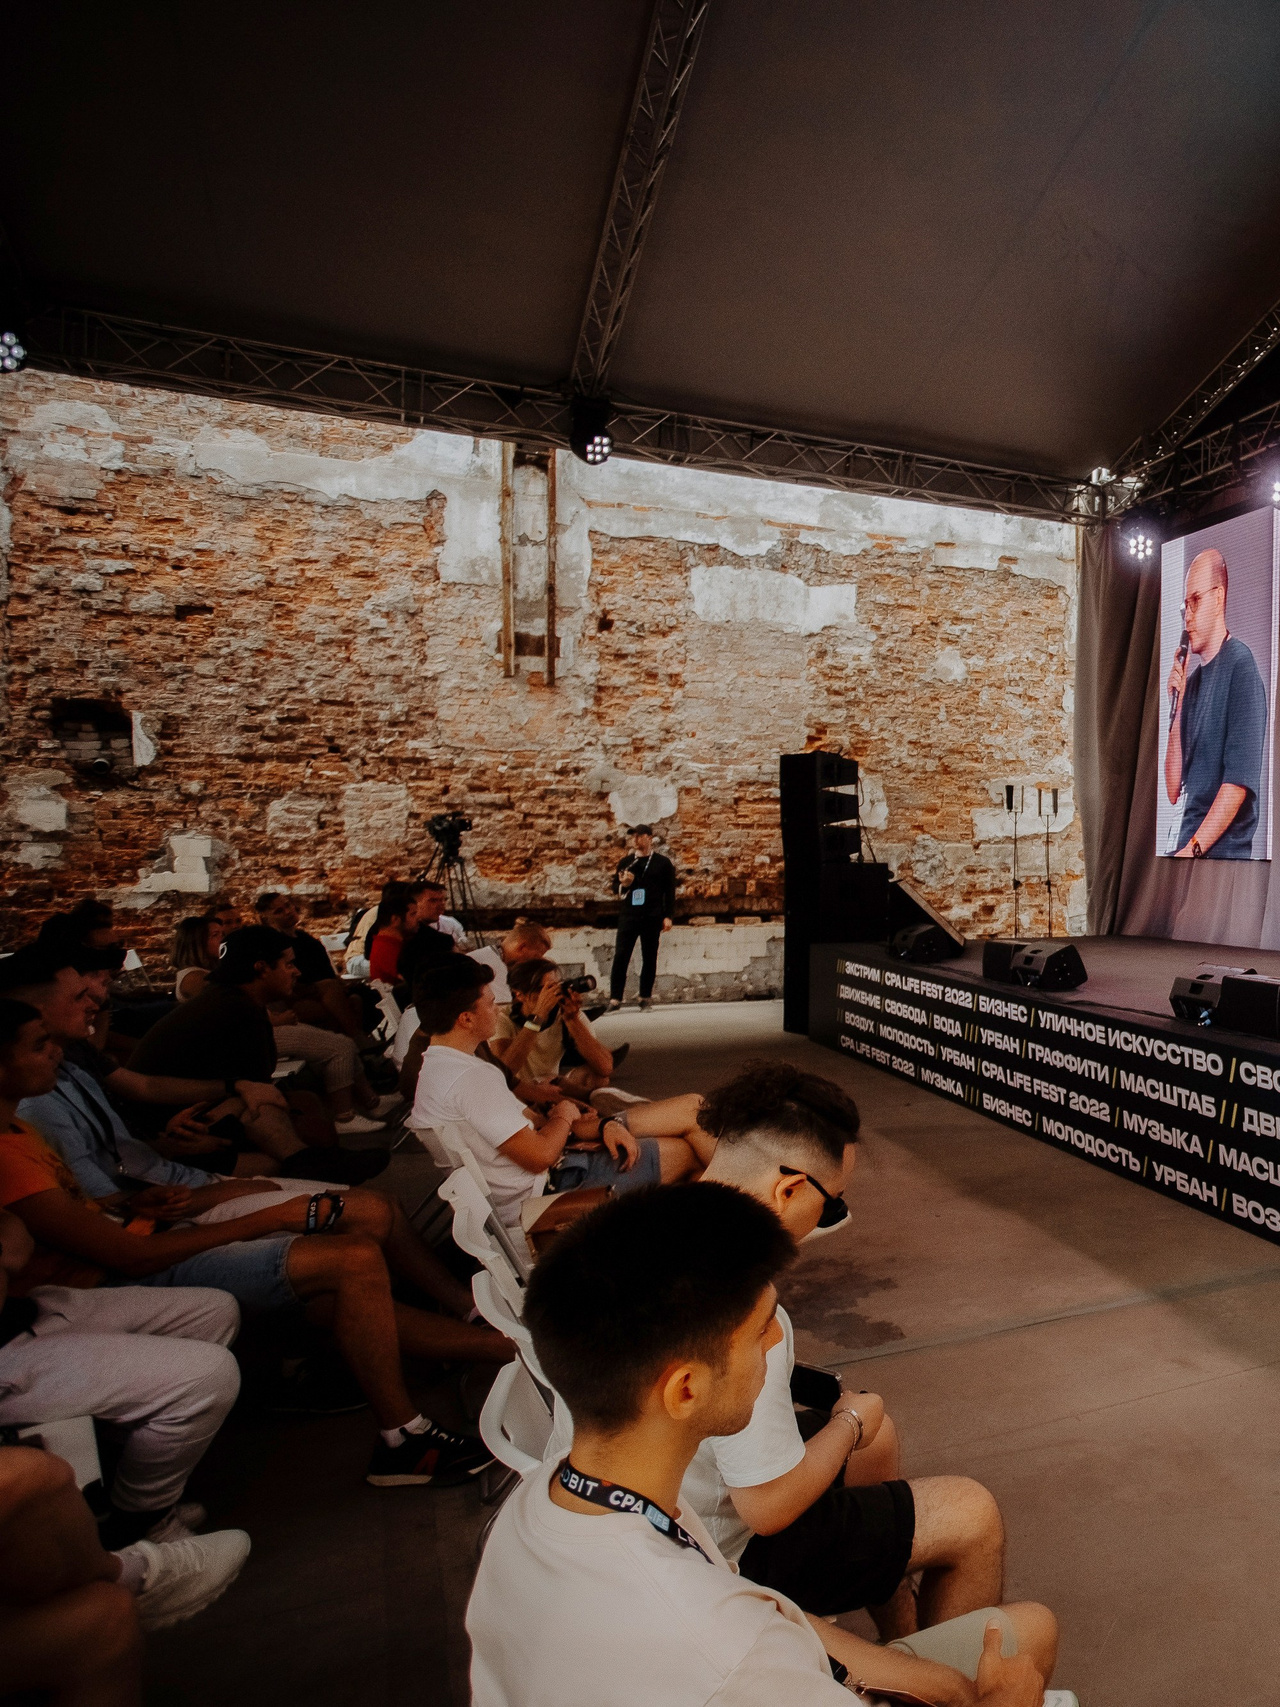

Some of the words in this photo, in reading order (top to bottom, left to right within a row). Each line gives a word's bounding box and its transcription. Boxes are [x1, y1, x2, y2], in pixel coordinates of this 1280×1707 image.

[839, 984, 881, 1009] ДВИЖЕНИЕ
[885, 998, 927, 1025] СВОБОДА
[934, 1015, 962, 1037] ВОДА
[980, 1028, 1020, 1055] УРБАН
[1028, 1042, 1109, 1084] ГРАФФИТИ
[1120, 1070, 1216, 1118] МАСШТАБ
[844, 1011, 874, 1034] ВОЗДУХ
[879, 1023, 935, 1057] МОЛОДОСТЬ
[940, 1045, 975, 1072] УРБАН
[981, 1060, 1005, 1083] CPA
[1007, 1069, 1031, 1093] LiFE
[1033, 1078, 1067, 1106] FEST
[1069, 1091, 1110, 1123] 2022
[1122, 1110, 1204, 1158] МУЗЫКА
[845, 961, 880, 982] ЭКСТРИМ
[885, 972, 902, 989] CPA
[921, 980, 943, 1000] FEST
[945, 987, 972, 1008] 2022
[979, 995, 1028, 1023] БИЗНЕС
[1038, 1010, 1106, 1045] УЛИЧНОЕ
[1108, 1027, 1223, 1076] ИСКУССТВО
[840, 1035, 855, 1052] CPA
[871, 1046, 890, 1066] FEST
[892, 1055, 915, 1077] 2022
[921, 1067, 963, 1098] МУЗЫКА
[982, 1092, 1032, 1127] БИЗНЕС
[1042, 1116, 1141, 1173] МОЛОДОСТЬ
[1152, 1161, 1218, 1207] УРБАН
[609, 1490, 644, 1514] CPA
